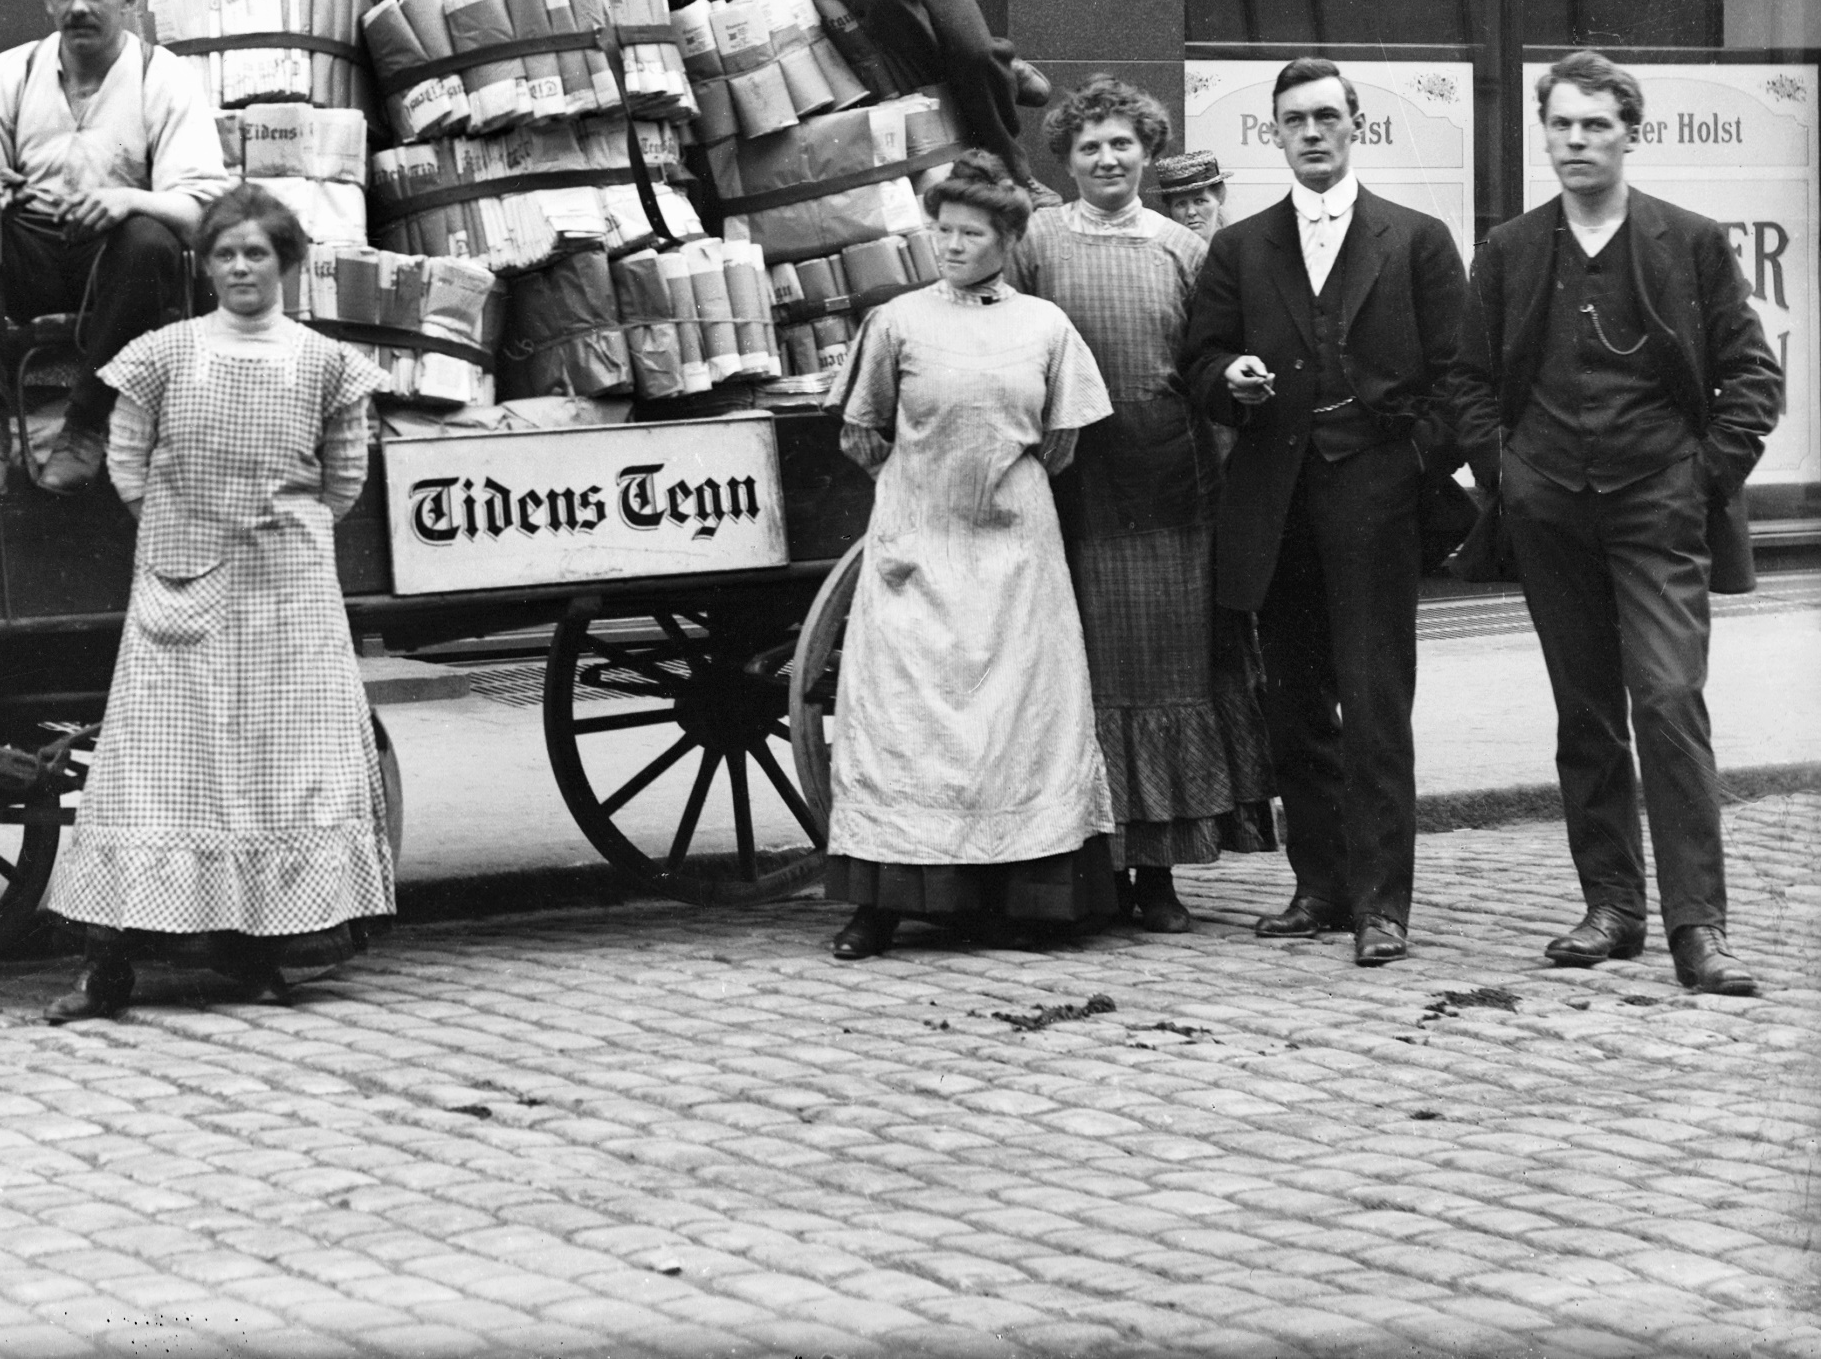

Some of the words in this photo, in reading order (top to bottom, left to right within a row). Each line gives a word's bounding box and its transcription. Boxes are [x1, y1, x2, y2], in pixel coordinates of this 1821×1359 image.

[244, 123, 298, 141] Tidens
[1240, 114, 1272, 145] Pe
[1638, 120, 1667, 144] er
[1678, 112, 1743, 144] Holst
[409, 475, 608, 546] Tidens
[616, 462, 762, 541] Tegn
